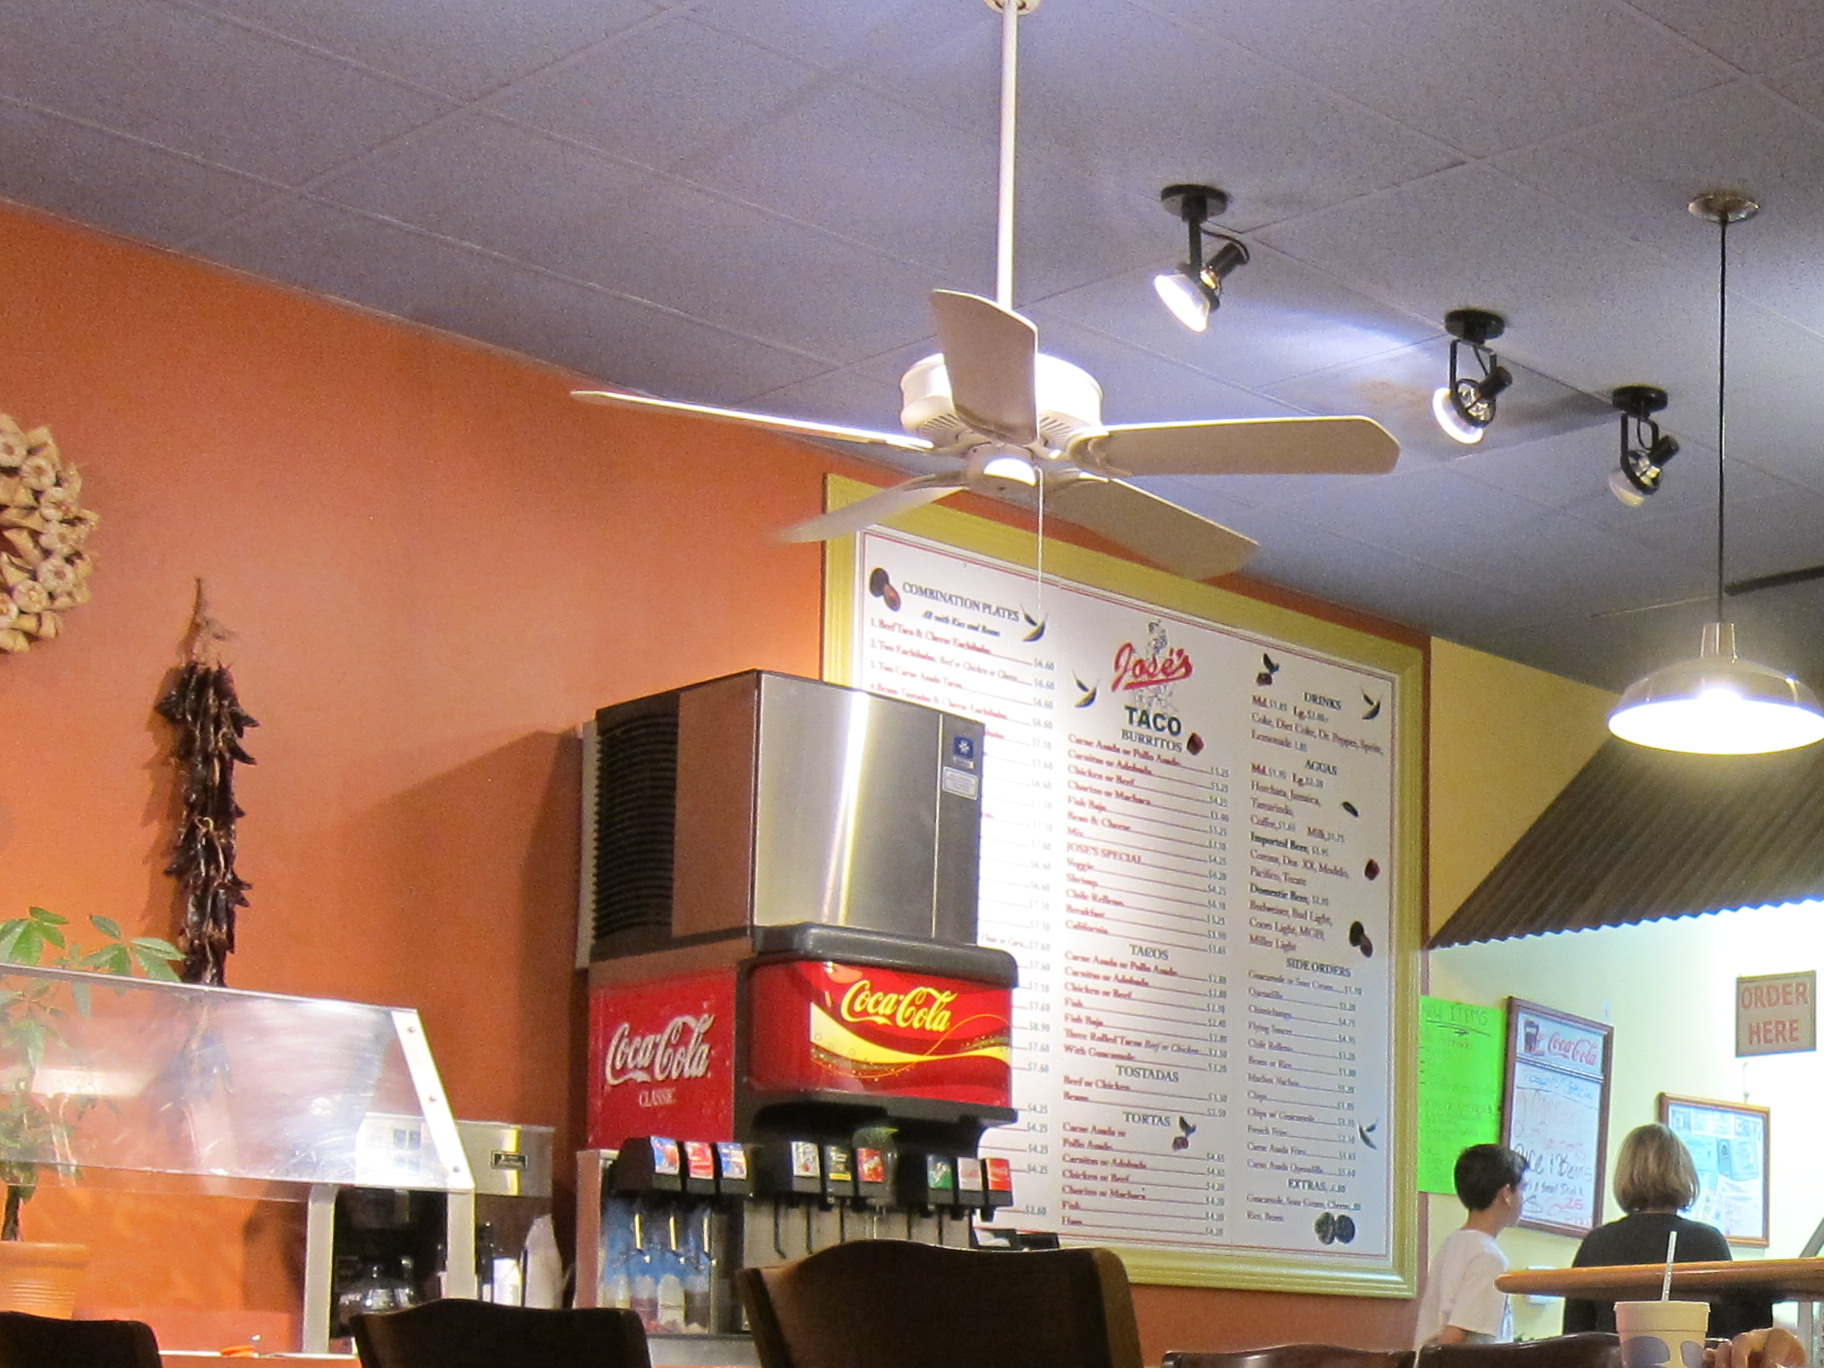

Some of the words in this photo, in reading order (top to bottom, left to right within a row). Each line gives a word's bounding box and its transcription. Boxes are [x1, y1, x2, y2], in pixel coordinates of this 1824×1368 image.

[902, 582, 981, 612] COMBINATION
[982, 602, 1020, 622] PLATES
[1304, 692, 1341, 710] DRINKS
[1124, 705, 1182, 737] TACO
[1121, 728, 1182, 753] BURRITOS
[1305, 760, 1337, 776] AGUAS
[1101, 848, 1142, 864] SPECIAL
[1129, 944, 1169, 960] TACOS
[1286, 957, 1310, 971] SIDE
[1312, 962, 1351, 978] ORDERS
[841, 980, 958, 1032] Coca-Cola
[1741, 982, 1810, 1010] ORDER
[1748, 1019, 1800, 1045] HERE
[605, 1014, 715, 1086] Coca-Cola
[1548, 1032, 1598, 1066] Coca-Cola
[1115, 1065, 1179, 1082] TOSTADAS
[1123, 1111, 1171, 1126] TORTAS
